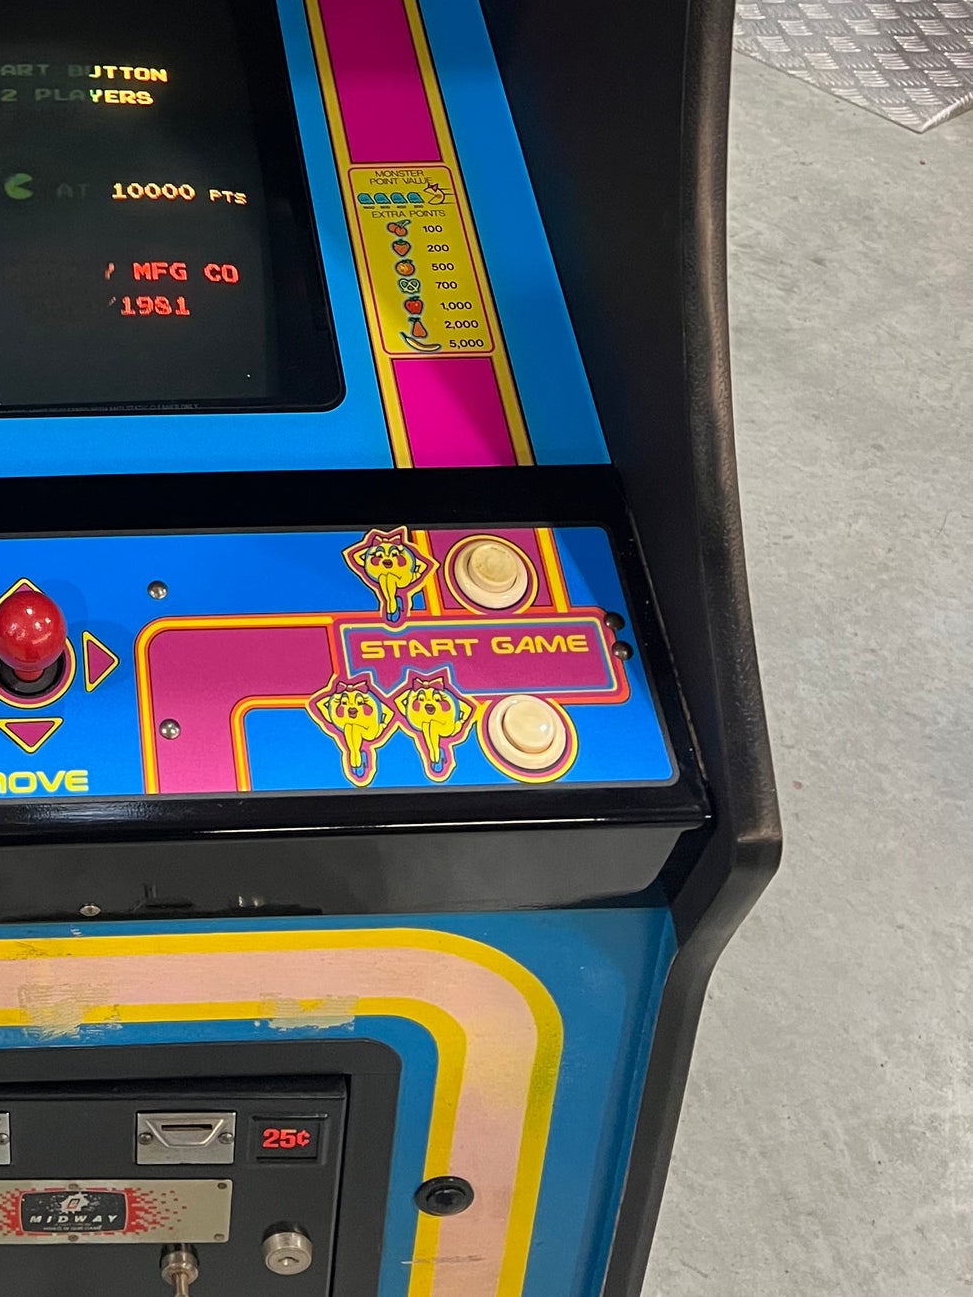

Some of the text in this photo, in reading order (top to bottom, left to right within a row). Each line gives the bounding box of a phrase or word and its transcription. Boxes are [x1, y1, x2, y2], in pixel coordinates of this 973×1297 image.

[68, 64, 168, 82] BUTTON
[1, 89, 18, 102] 2
[35, 89, 154, 105] PLAYERS
[375, 169, 424, 178] MONSTER
[370, 177, 399, 185] POINT
[57, 183, 90, 199] AT
[112, 182, 196, 201] 10000
[209, 188, 248, 205] PTS
[372, 209, 446, 219] EXTRA POINTS
[423, 225, 443, 233] 100
[427, 244, 450, 253] 200
[431, 262, 455, 271] 500
[133, 262, 187, 282] MFG
[204, 263, 240, 283] CO
[435, 281, 458, 290] 700
[440, 301, 473, 311] 1,000
[444, 320, 479, 330] 2,000
[449, 339, 484, 349] 5,000
[360, 634, 589, 659] START GAME
[262, 1128, 311, 1149] 25¢
[30, 1215, 118, 1224] MIDWAY
